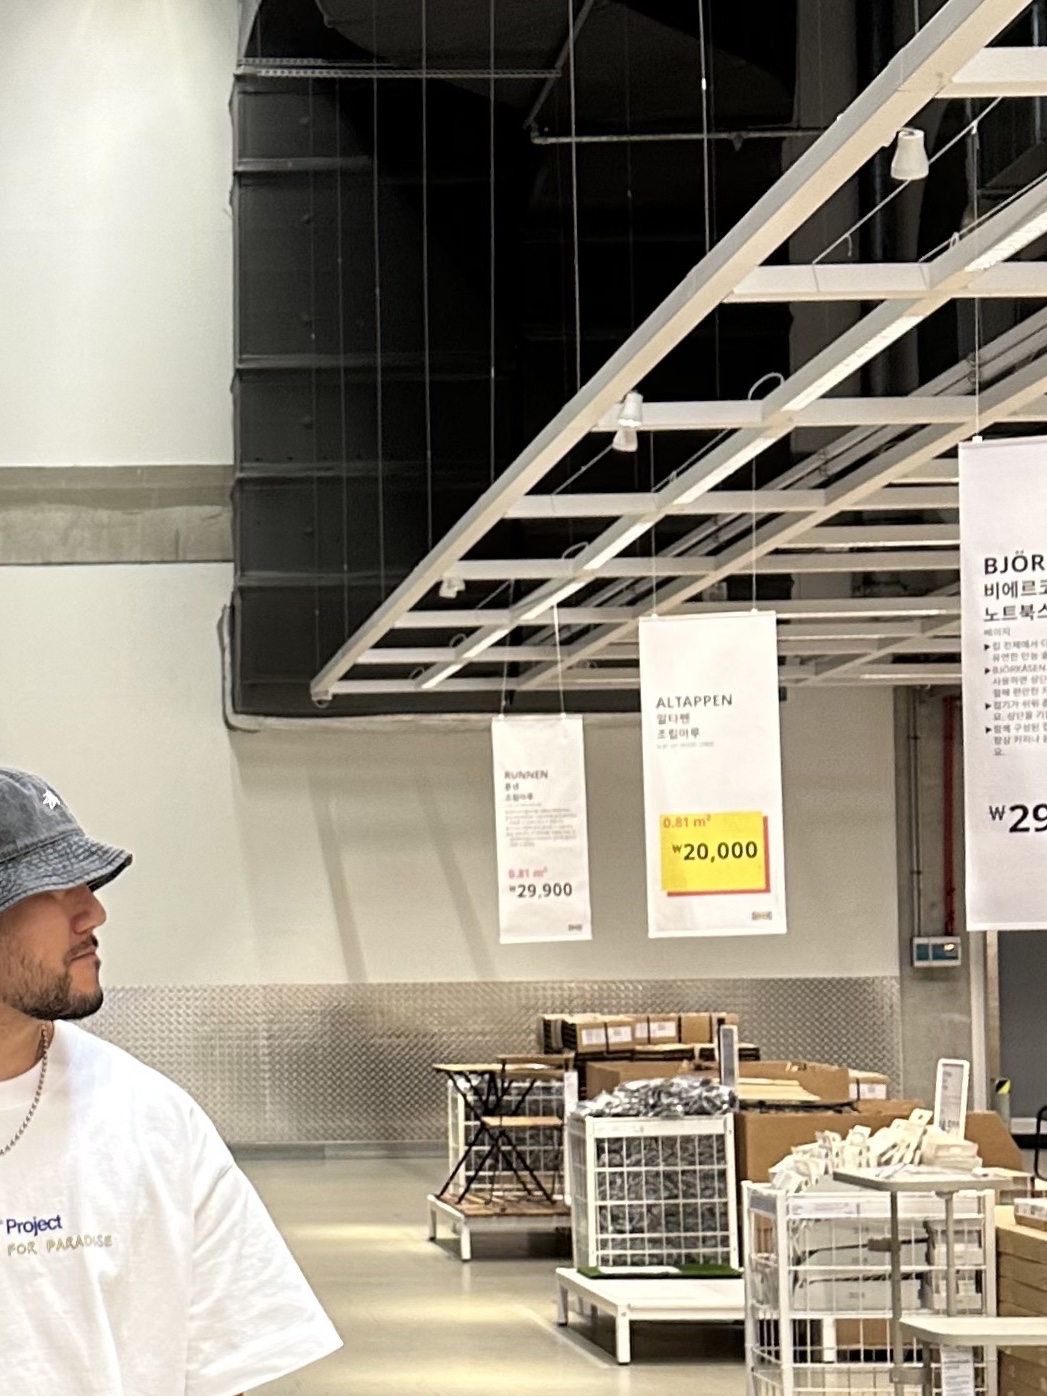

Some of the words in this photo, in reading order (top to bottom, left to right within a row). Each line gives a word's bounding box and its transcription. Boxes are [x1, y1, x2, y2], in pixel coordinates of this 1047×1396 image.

[984, 549, 1046, 575] BJÖR
[656, 694, 733, 709] ALTAPPEN
[663, 817, 689, 828] 0.81
[6, 1214, 63, 1236] Project
[7, 1241, 38, 1257] FOR
[47, 1234, 113, 1253] PARADISE
